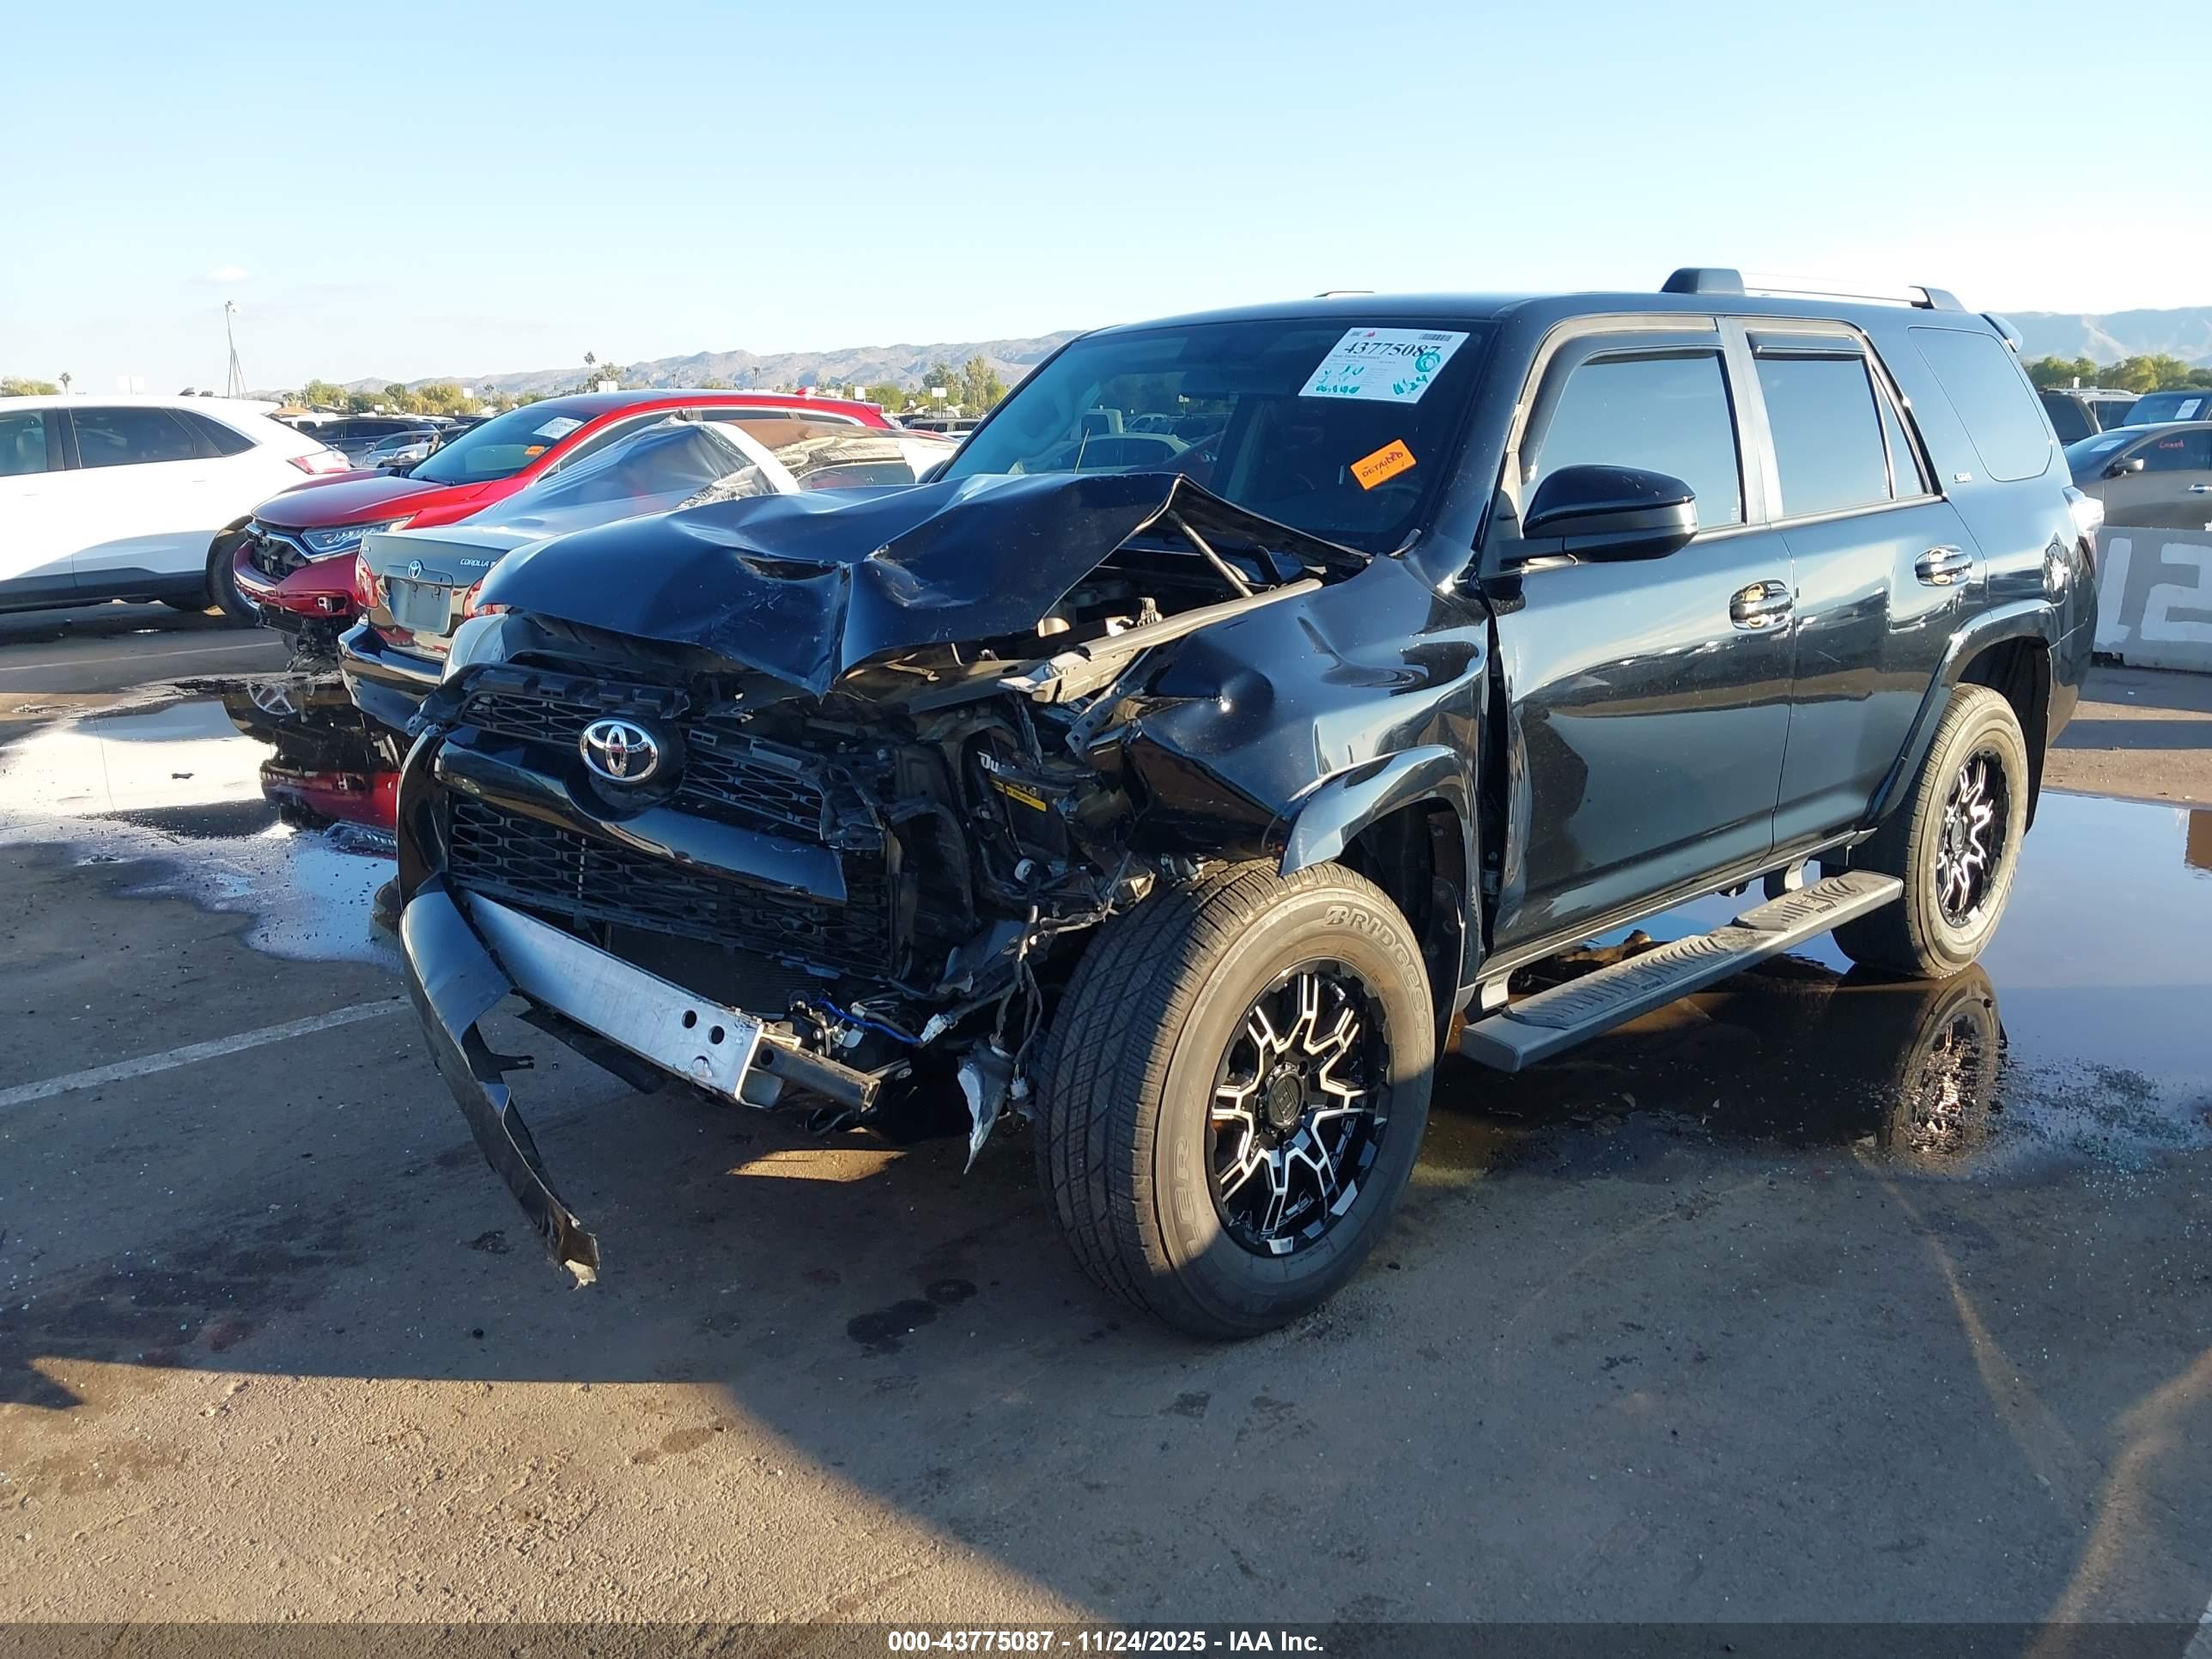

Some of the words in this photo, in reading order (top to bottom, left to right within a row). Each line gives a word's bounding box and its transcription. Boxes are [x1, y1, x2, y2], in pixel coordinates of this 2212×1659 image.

[1344, 342, 1442, 357] 43775087
[459, 558, 490, 567] COROLLA
[1324, 906, 1434, 1121] BRIDGESTO
